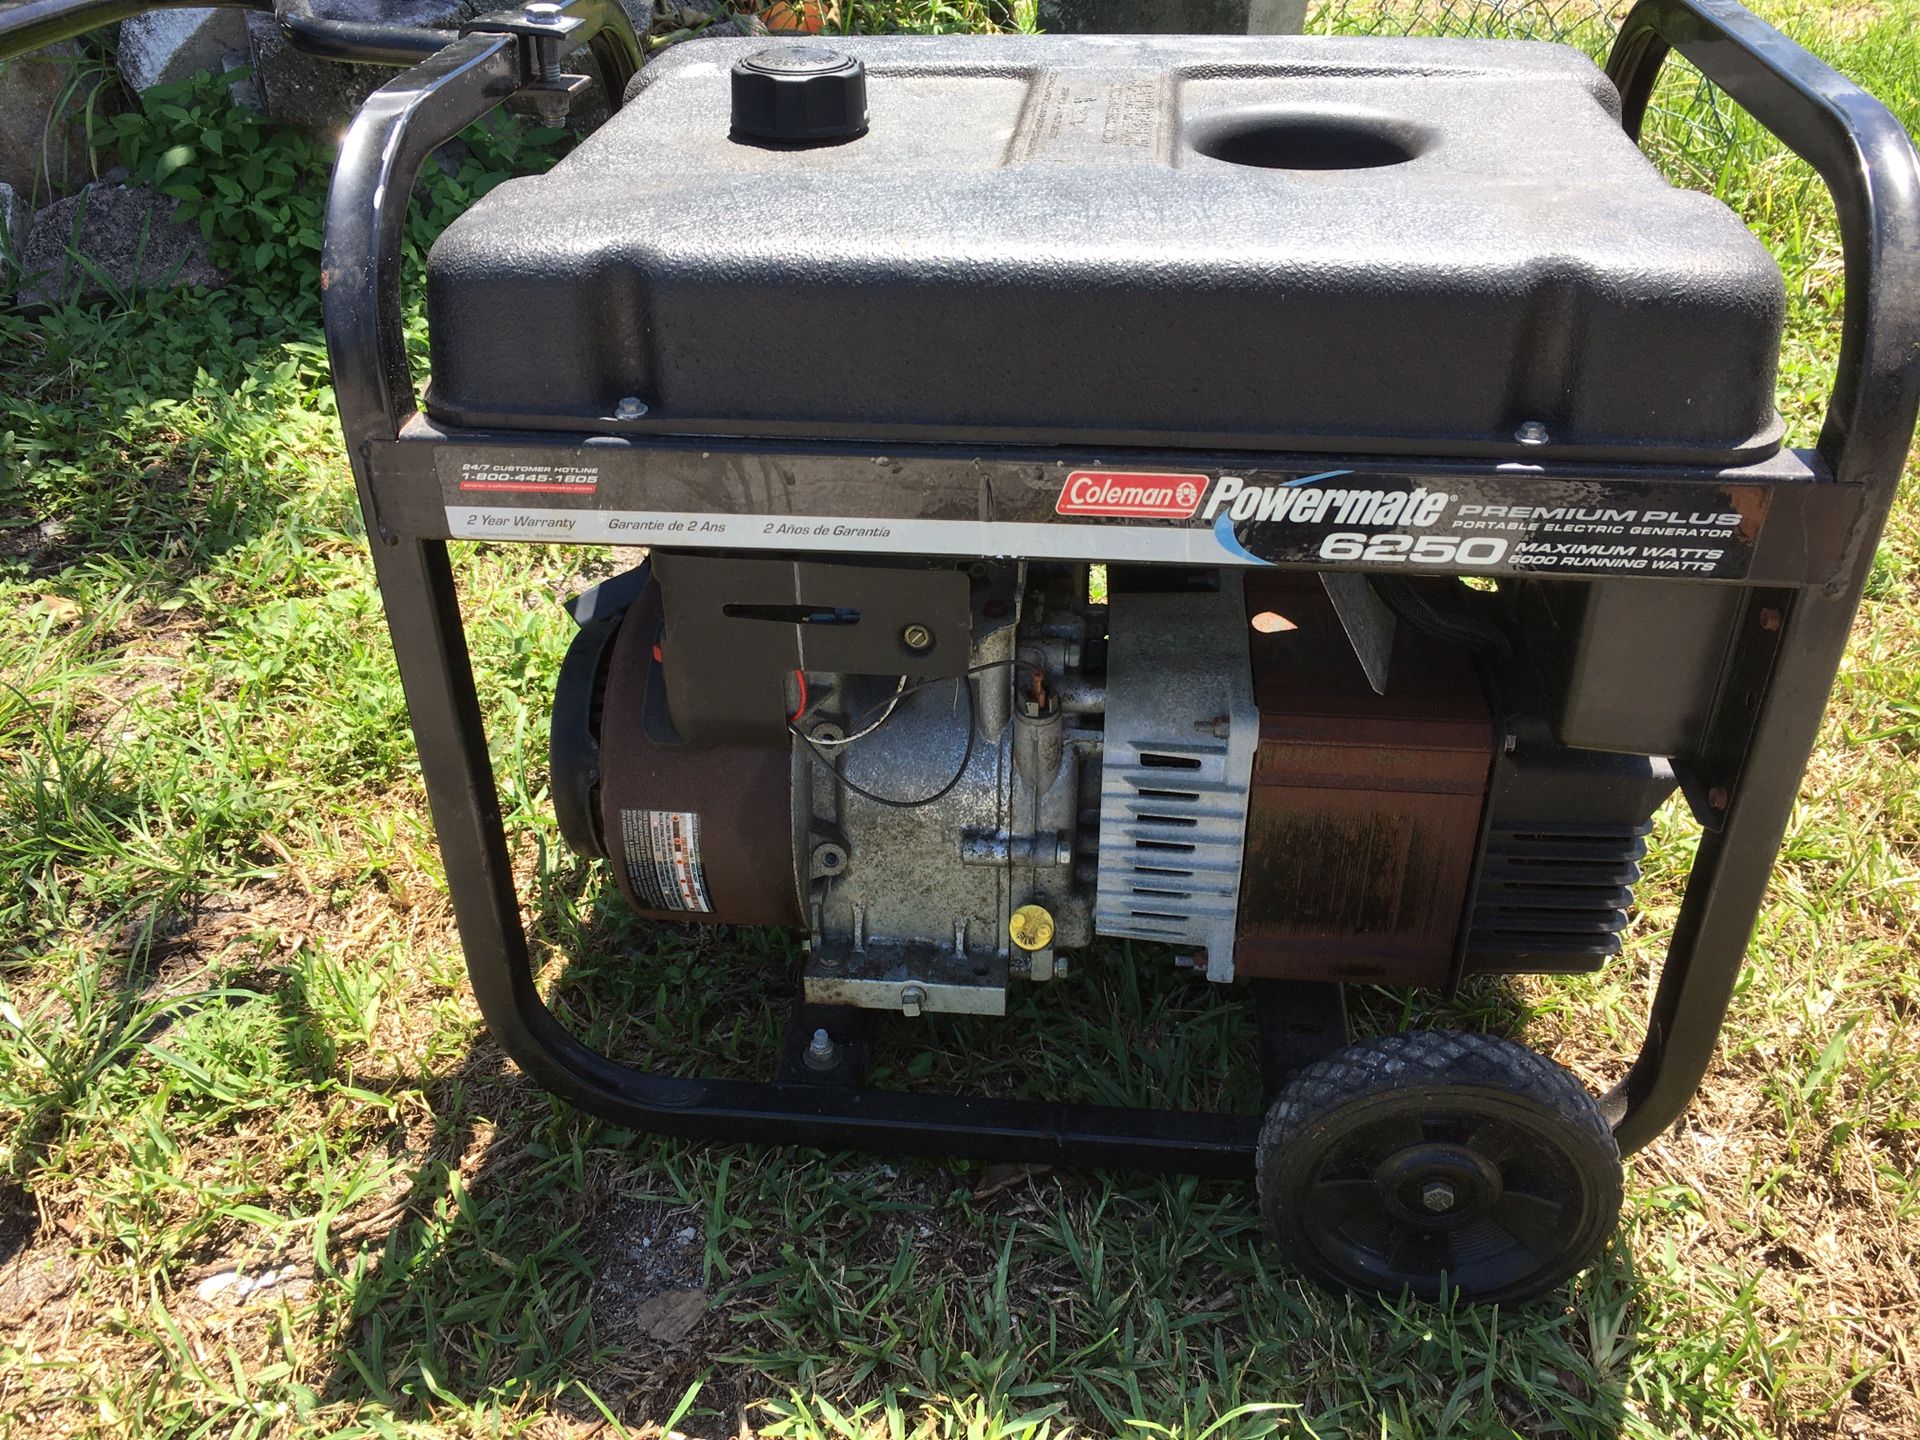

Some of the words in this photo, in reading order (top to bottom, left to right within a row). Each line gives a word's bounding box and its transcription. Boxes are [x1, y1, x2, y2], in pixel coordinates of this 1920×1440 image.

[462, 463, 490, 471] 24/7
[493, 465, 551, 473] CUSTOMER
[462, 472, 599, 484] 1-800-445-1805
[1070, 477, 1173, 506] Coleman
[467, 514, 478, 525] 2
[481, 514, 510, 526] Year
[514, 515, 576, 531] Warranty
[1457, 504, 1638, 522] PREMIUM
[1641, 510, 1743, 526] PLUS
[608, 518, 665, 531] Garantie
[667, 520, 684, 531] de
[687, 520, 698, 532] 2
[700, 520, 726, 533] Ans
[763, 523, 774, 534] 2
[776, 523, 811, 535] Años
[813, 524, 830, 536] de
[1452, 520, 1540, 531] PORTABLE
[1543, 523, 1625, 534] ELECTRIC
[1629, 526, 1733, 538] GENERATOR
[1319, 532, 1508, 565] 6250
[1514, 542, 1637, 556] MAXIMUM
[1641, 546, 1725, 560] WATTS
[1507, 554, 1558, 565] 5000
[1560, 556, 1648, 569] RUNNING
[1651, 560, 1717, 572] WATTS
